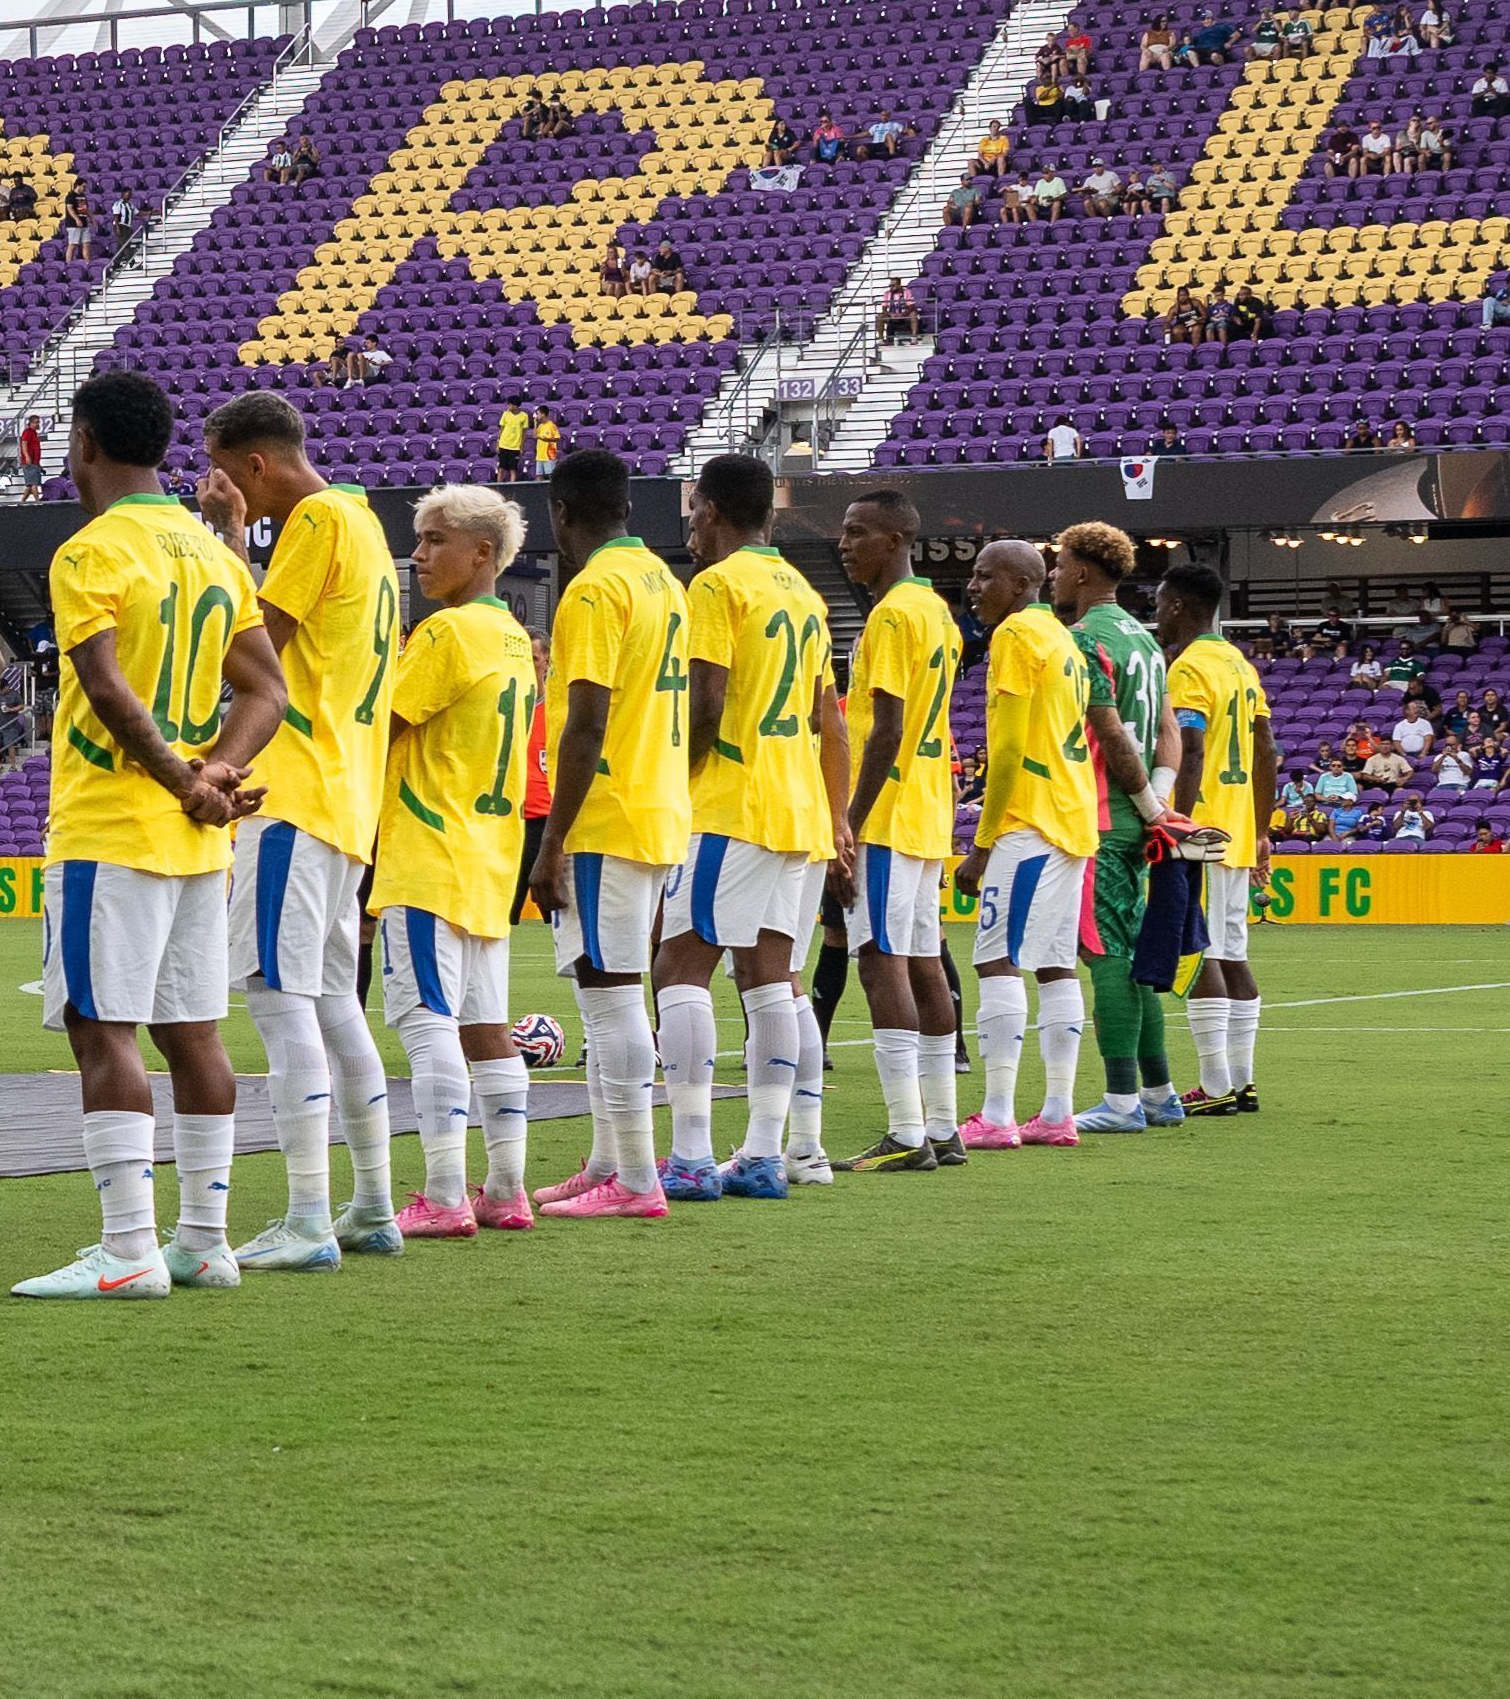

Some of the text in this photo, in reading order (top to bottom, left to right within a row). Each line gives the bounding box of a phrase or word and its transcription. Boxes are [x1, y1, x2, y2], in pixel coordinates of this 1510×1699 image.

[780, 381, 813, 399] 132
[838, 377, 861, 396] 33
[151, 580, 235, 746] 10
[355, 575, 396, 726] 9
[656, 612, 688, 747] 4
[1319, 868, 1371, 918] FC
